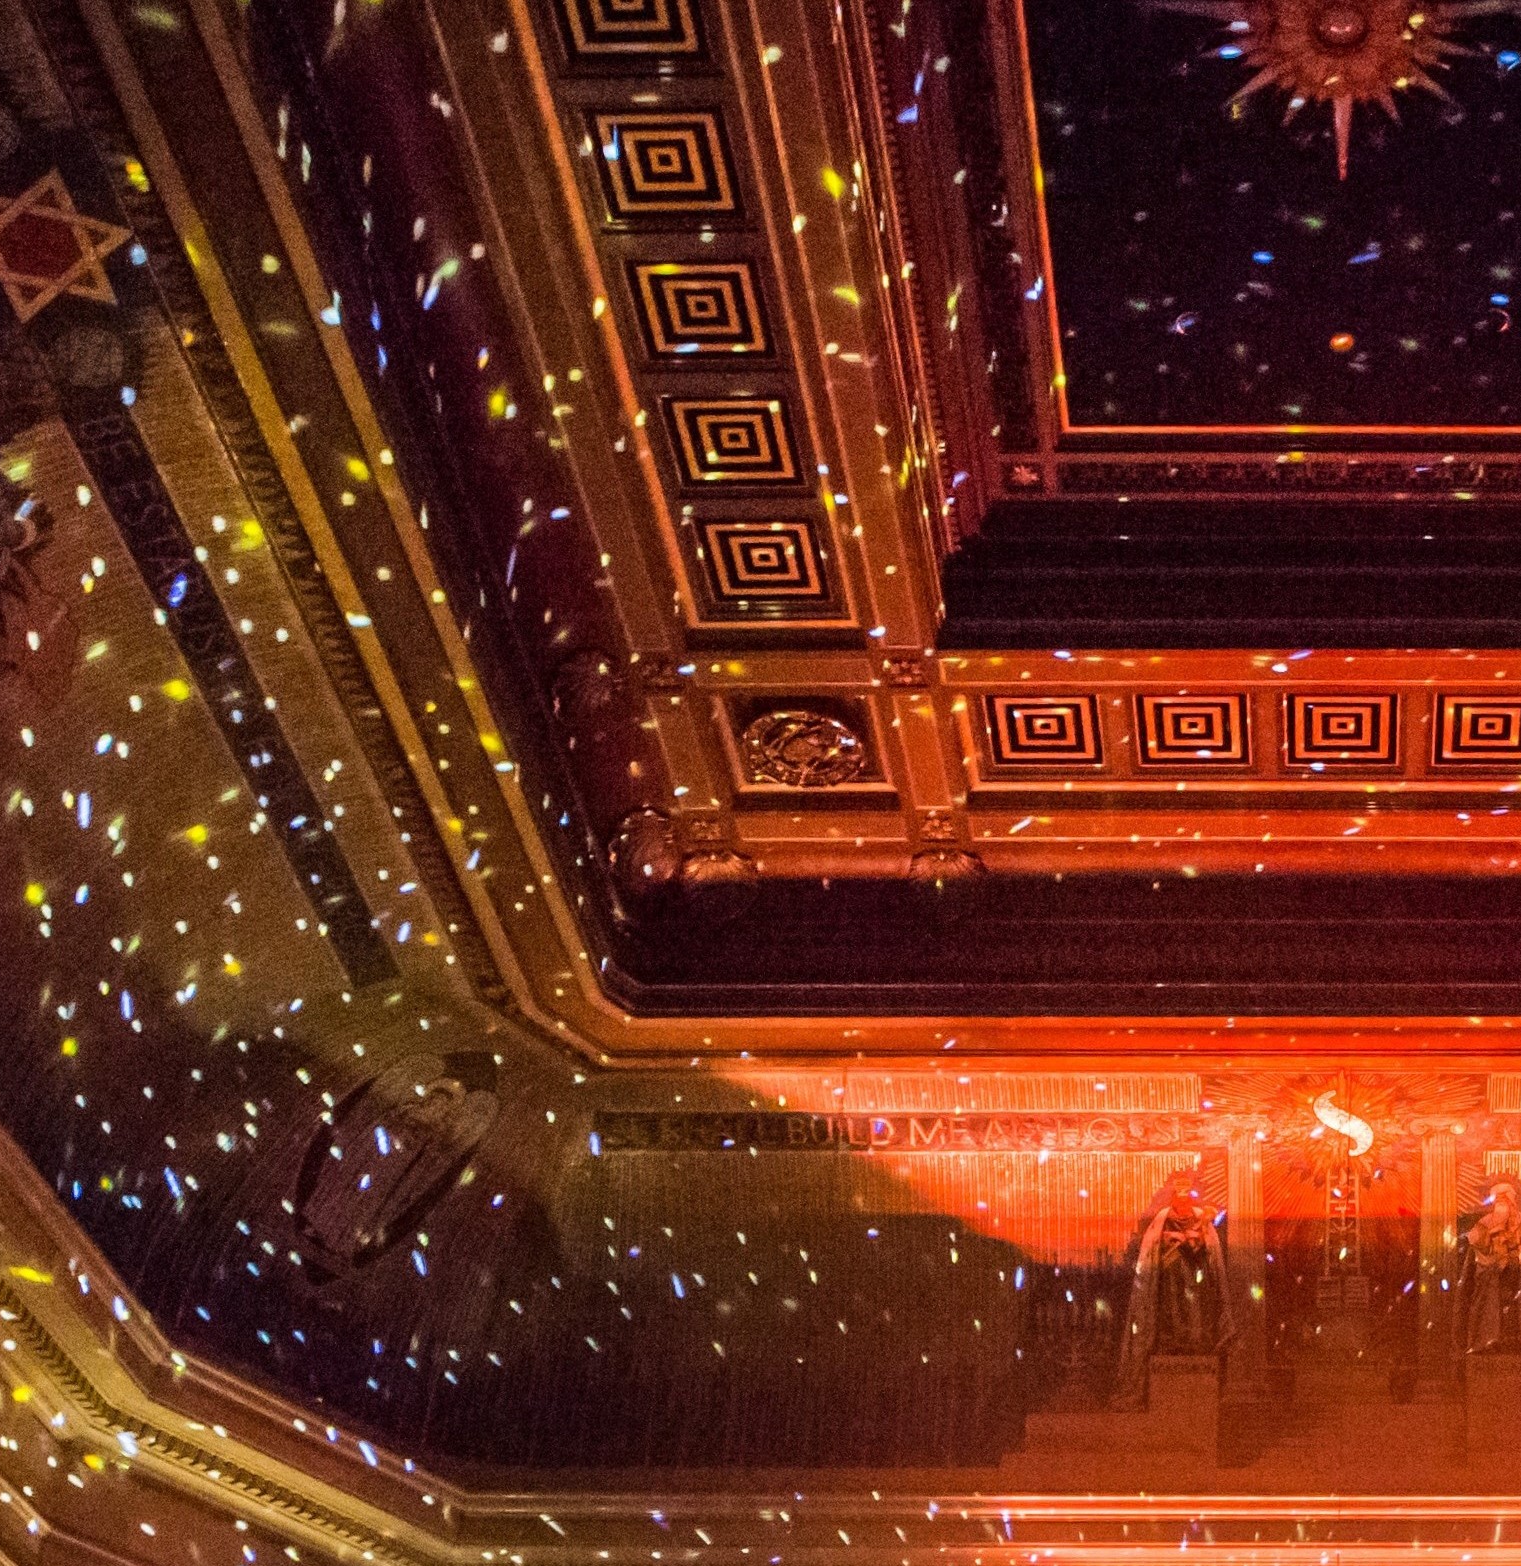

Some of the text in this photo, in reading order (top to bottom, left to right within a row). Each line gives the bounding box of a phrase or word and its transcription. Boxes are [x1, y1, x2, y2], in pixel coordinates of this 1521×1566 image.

[786, 1115, 895, 1146] BUILD
[909, 1116, 969, 1146] ME
[1056, 1116, 1200, 1146] HOSE
